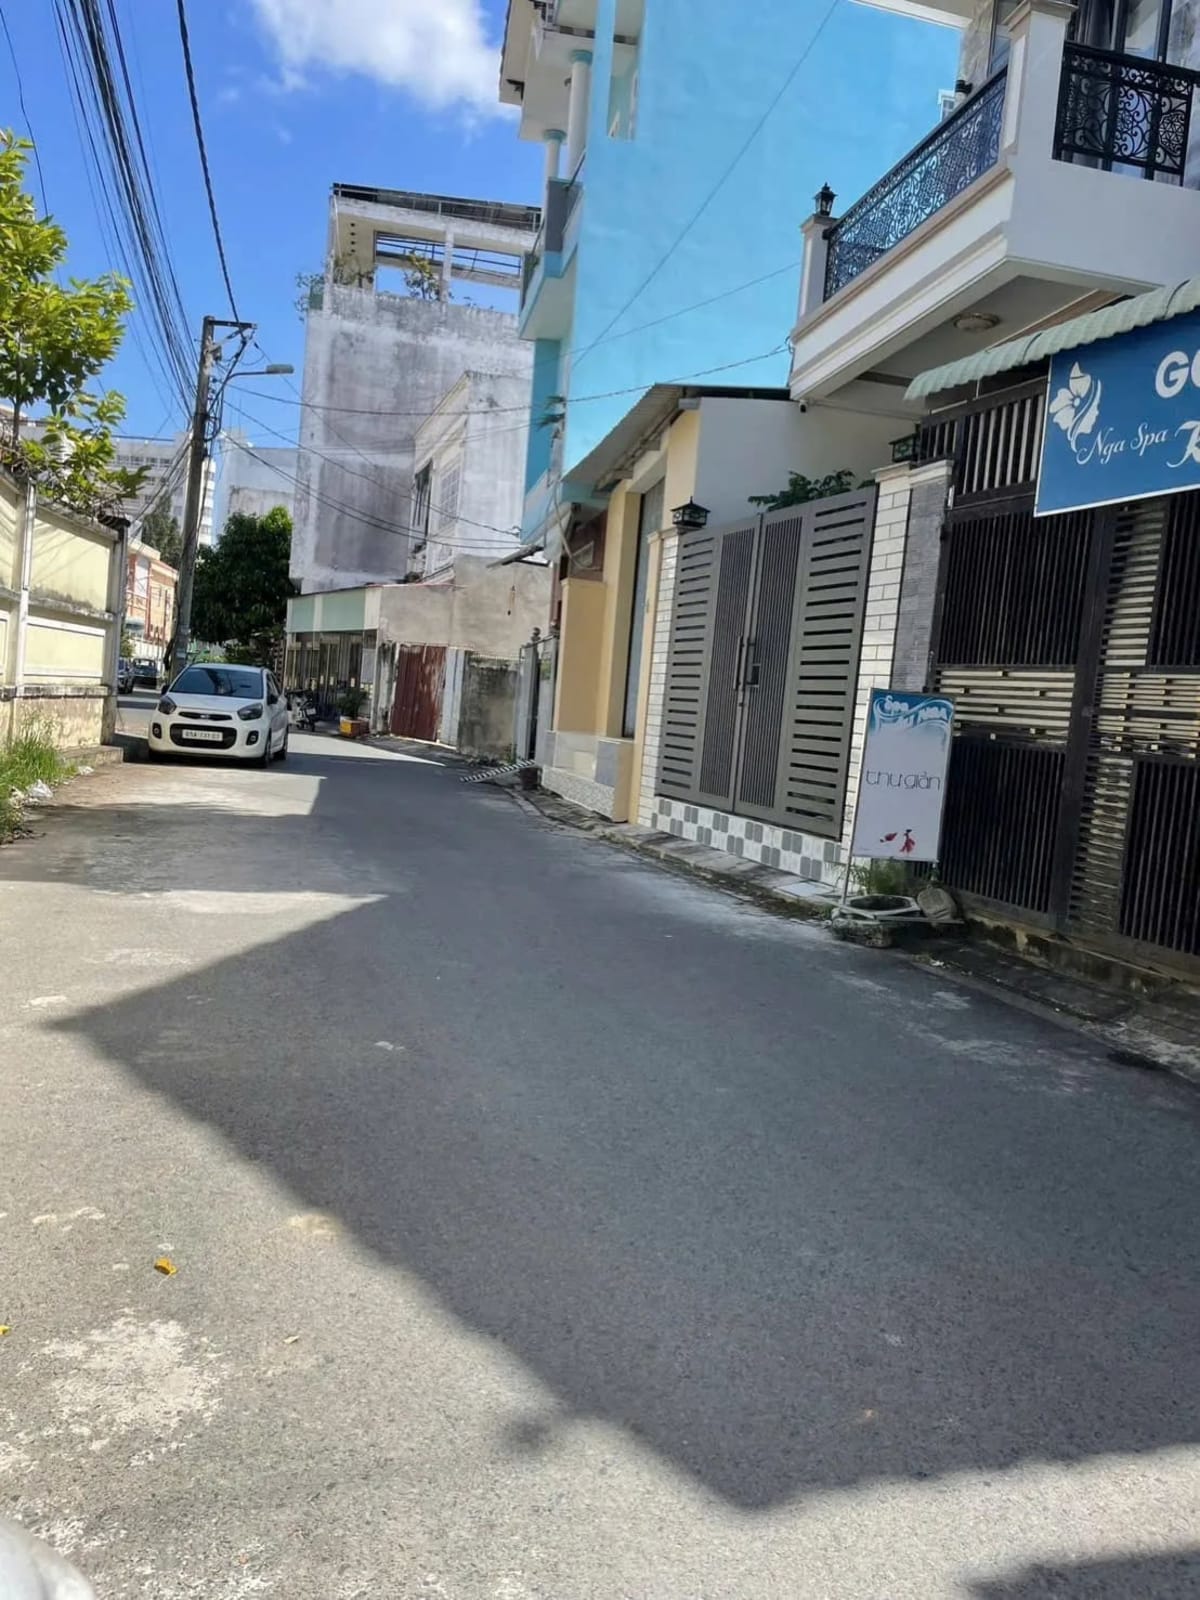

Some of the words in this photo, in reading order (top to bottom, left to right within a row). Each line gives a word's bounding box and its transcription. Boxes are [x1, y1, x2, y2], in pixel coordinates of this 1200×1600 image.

[1156, 349, 1200, 398] G
[1076, 427, 1125, 465] Nga
[1130, 423, 1168, 456] Spa
[884, 695, 909, 715] Spa
